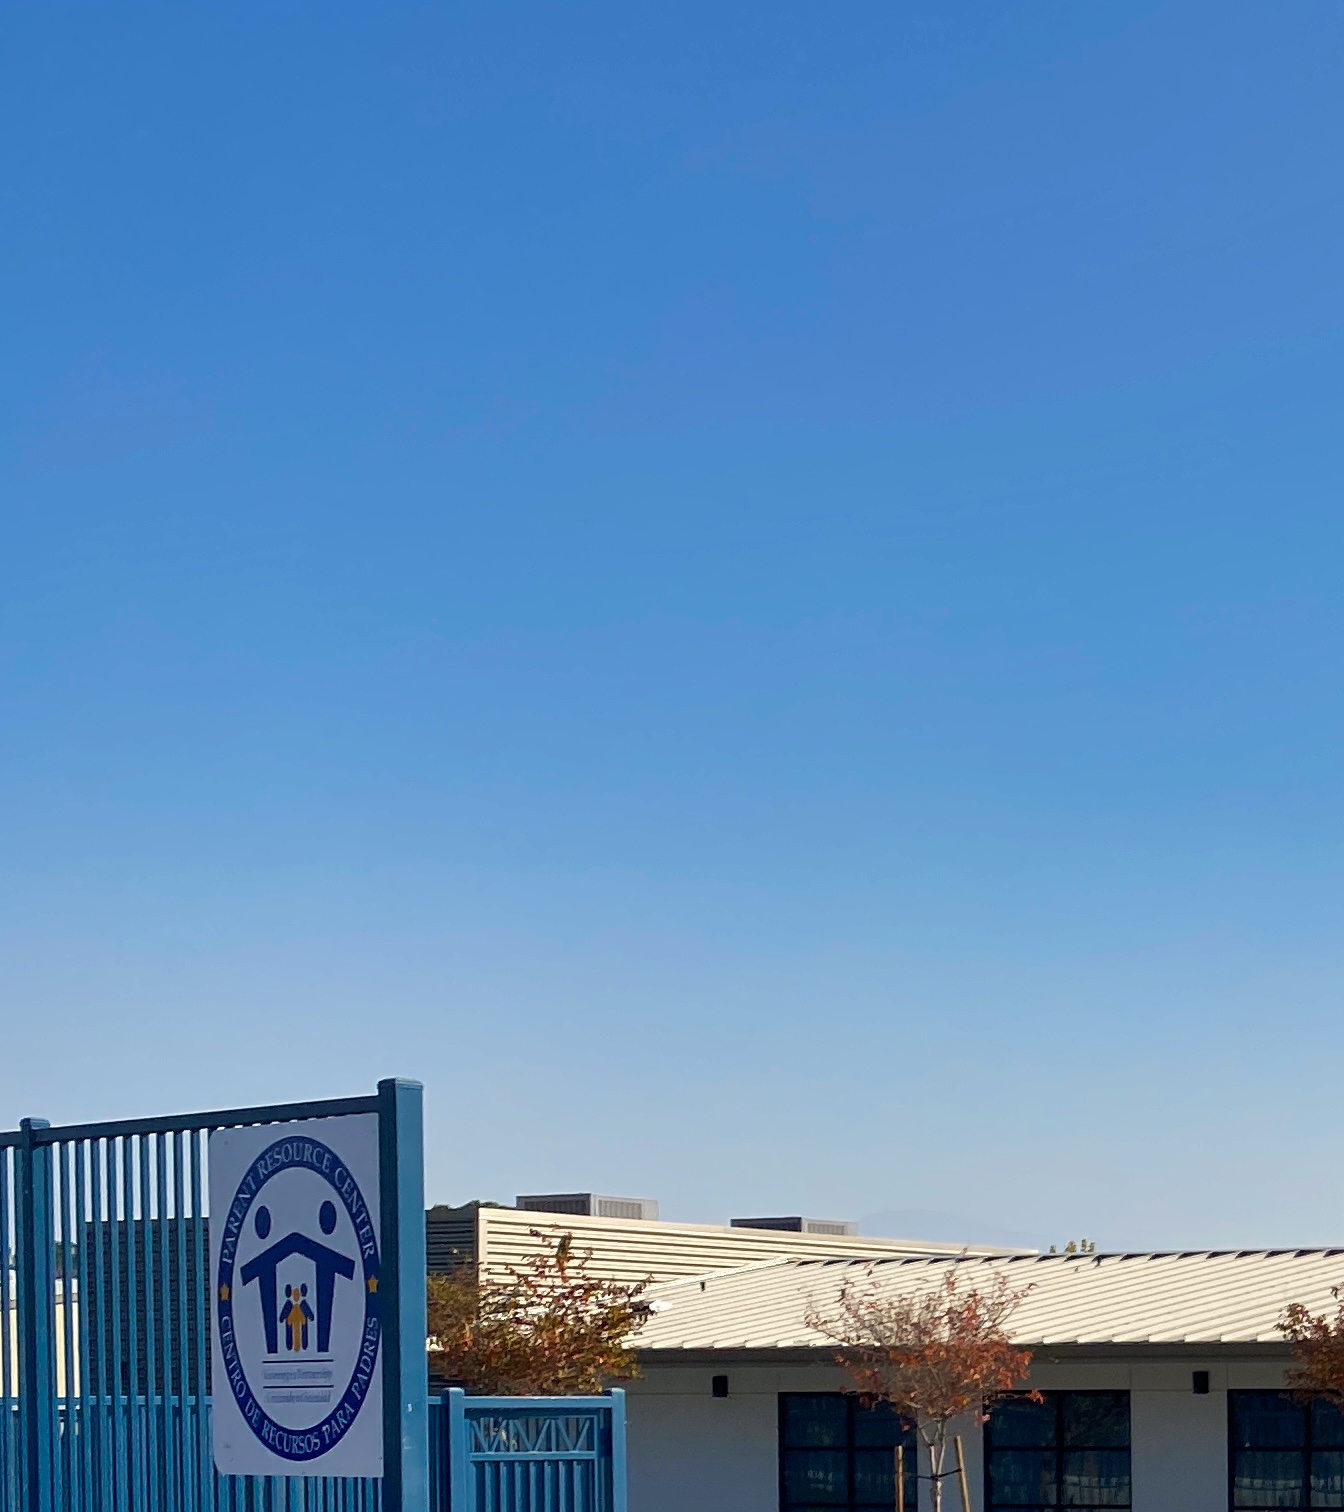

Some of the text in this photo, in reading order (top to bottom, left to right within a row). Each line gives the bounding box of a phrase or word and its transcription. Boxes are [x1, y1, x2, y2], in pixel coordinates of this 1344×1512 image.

[222, 1142, 375, 1264] PARENT RESOURCE CENTER
[222, 1315, 378, 1454] CENTRO DE RECURSOS PARA PADRES
